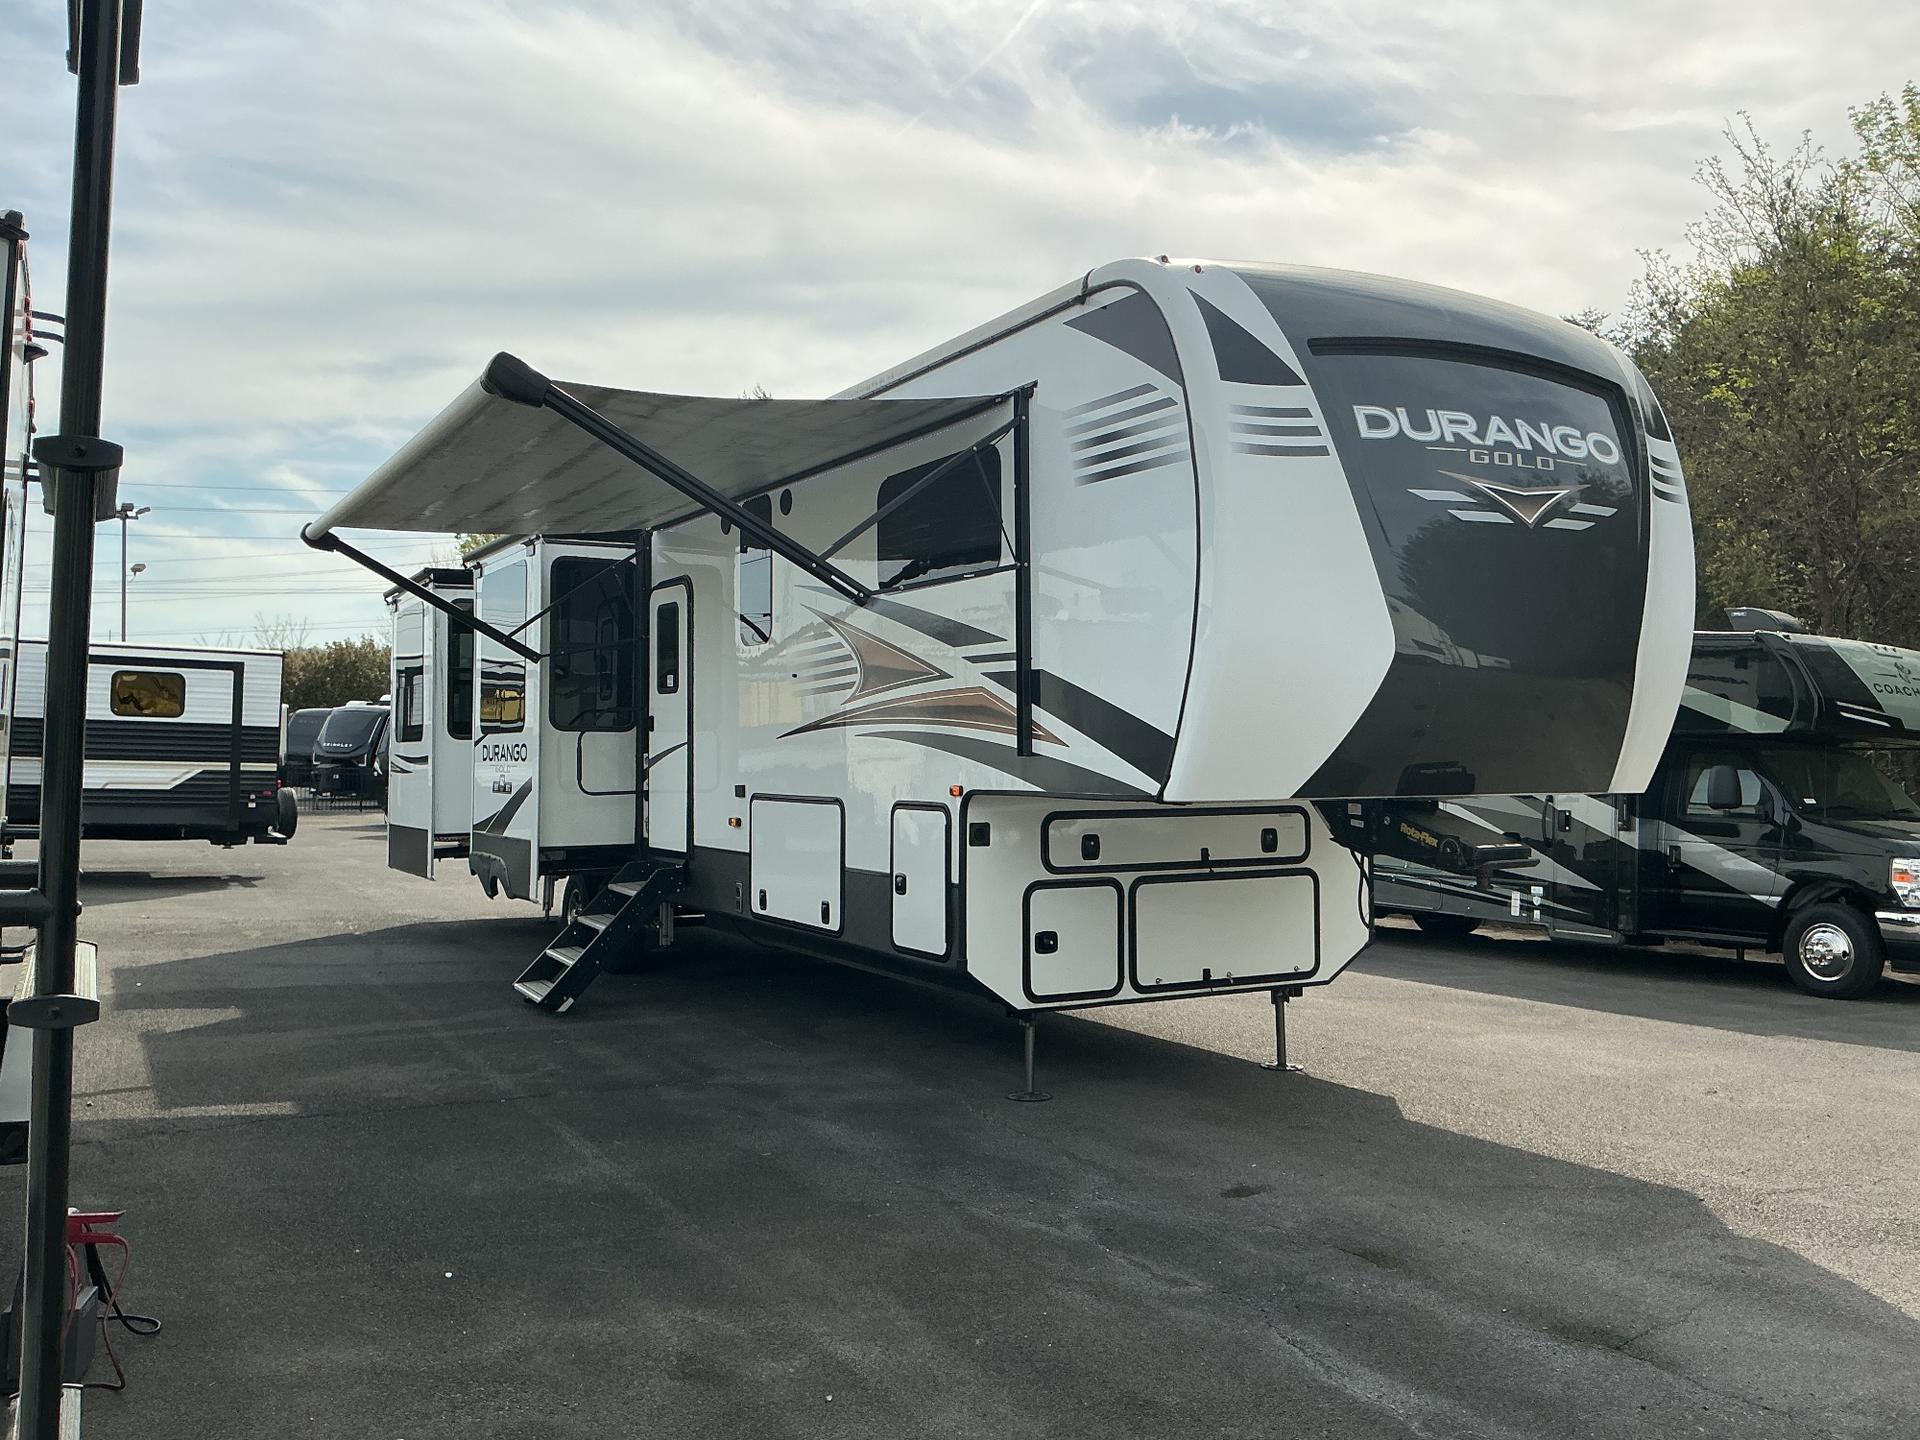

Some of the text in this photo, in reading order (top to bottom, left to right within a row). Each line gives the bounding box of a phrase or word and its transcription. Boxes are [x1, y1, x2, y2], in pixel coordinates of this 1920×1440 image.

[1352, 404, 1620, 465] DURANGO
[1468, 449, 1556, 471] GOLD
[482, 743, 528, 762] DURANGO
